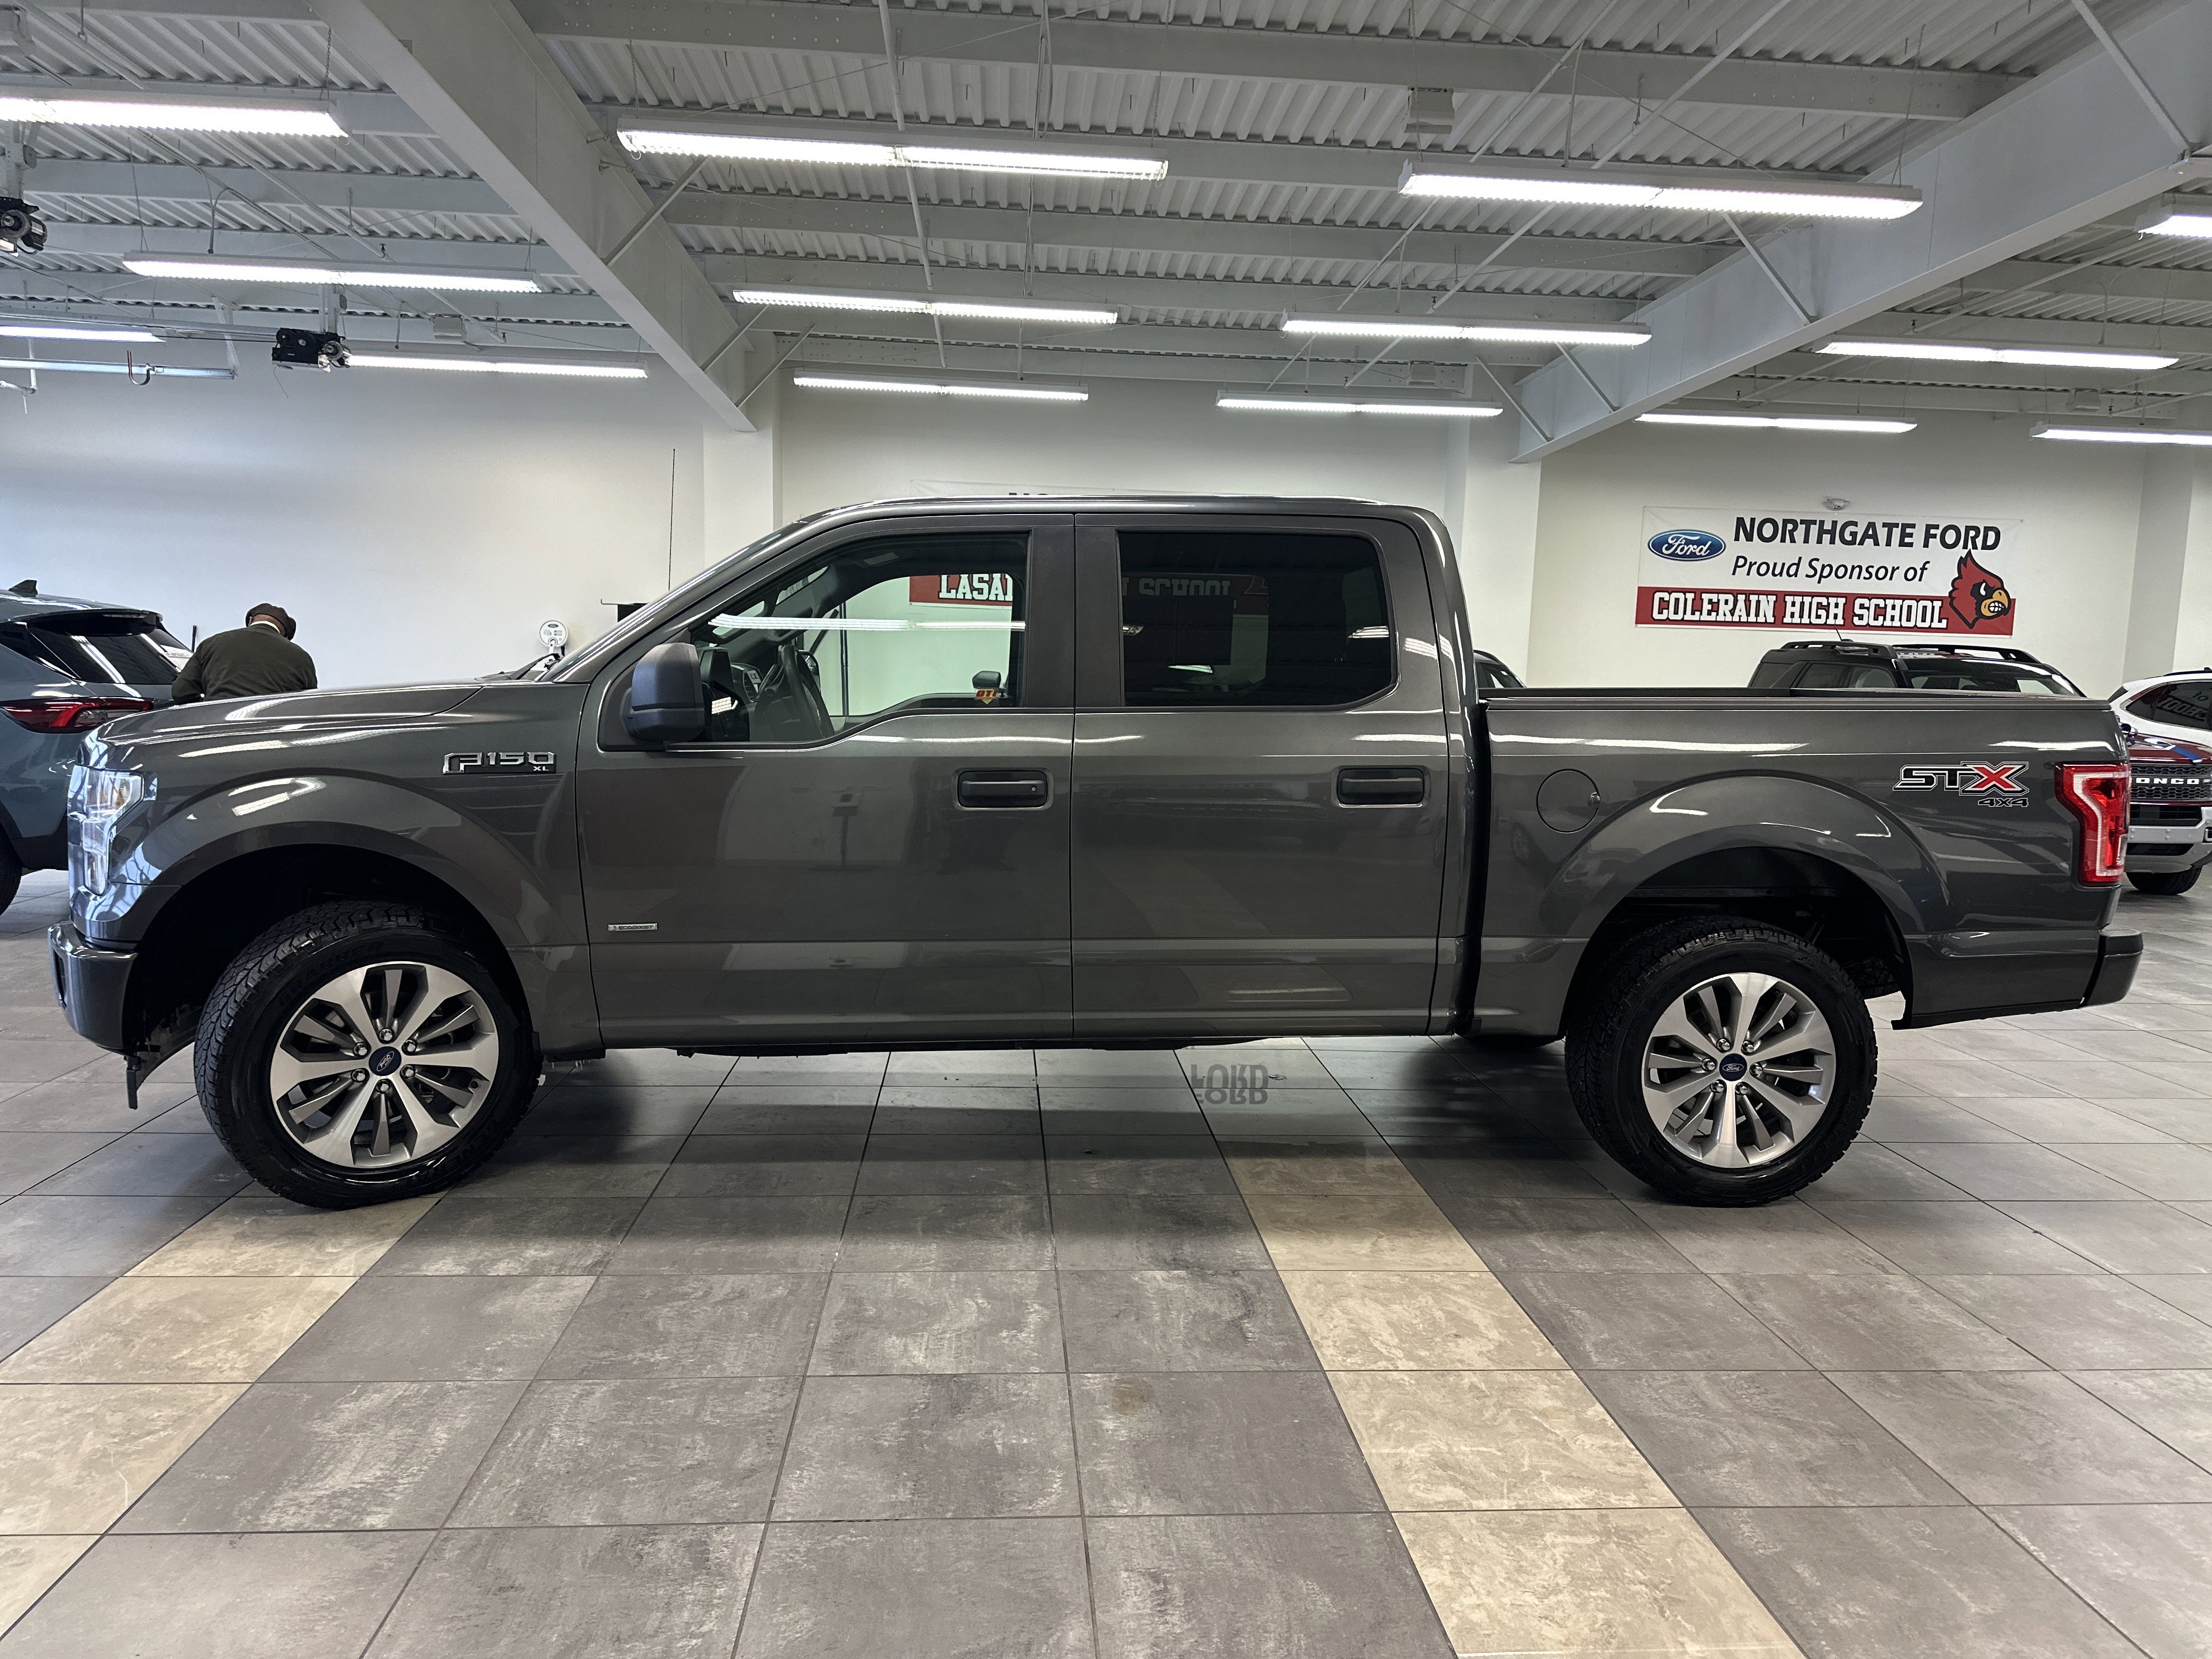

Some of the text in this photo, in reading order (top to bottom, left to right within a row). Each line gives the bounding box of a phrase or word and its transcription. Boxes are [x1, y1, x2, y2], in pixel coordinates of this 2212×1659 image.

[1662, 534, 1712, 556] Ford
[1734, 517, 2001, 550] NORTHGATE FORD
[1731, 555, 1931, 584] Proud Sponsor of
[1651, 591, 1948, 629] COLERAIN HIGH SCHOOL
[443, 751, 555, 774] F150
[1893, 761, 2029, 796] STX
